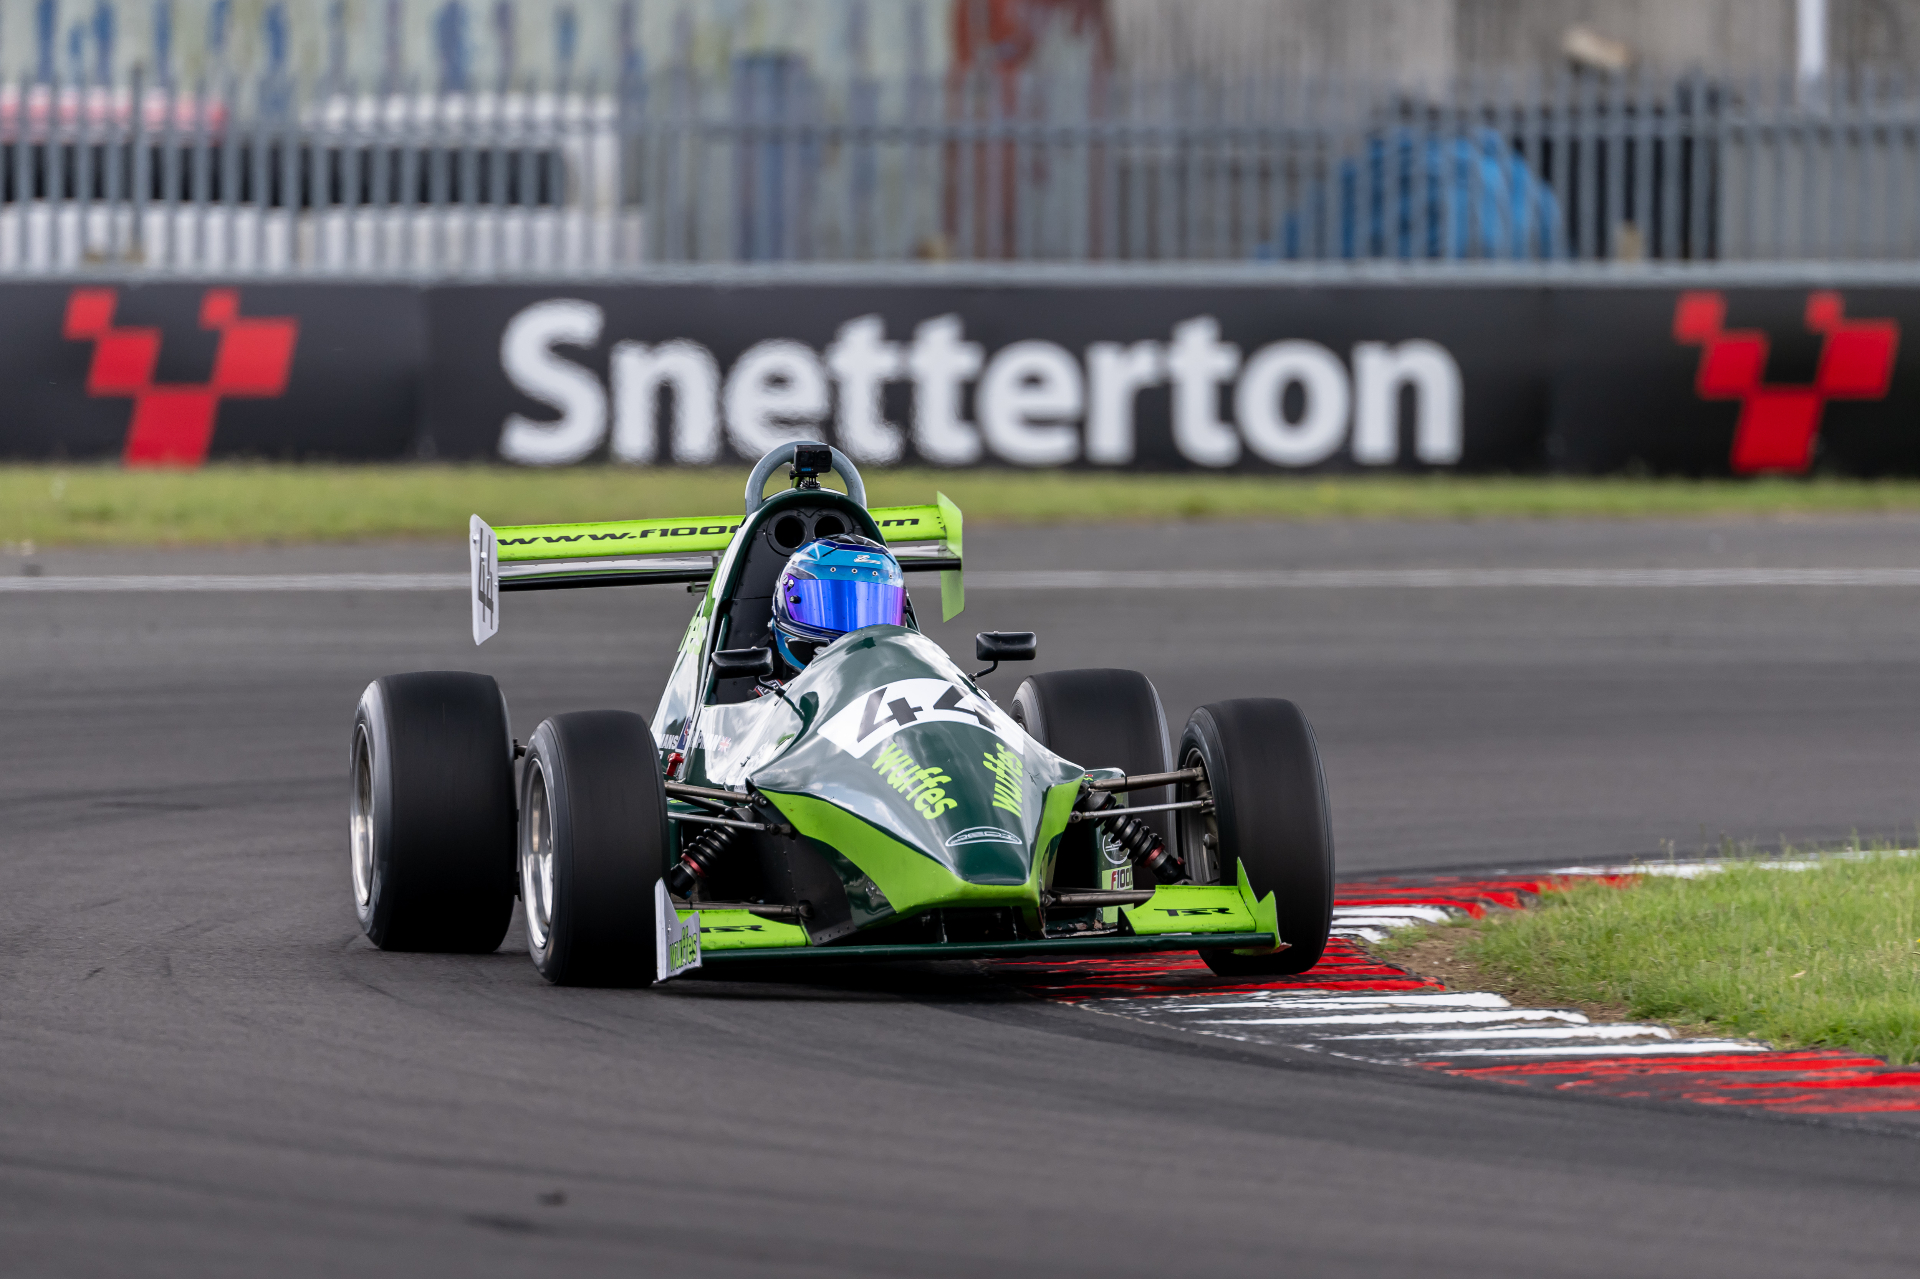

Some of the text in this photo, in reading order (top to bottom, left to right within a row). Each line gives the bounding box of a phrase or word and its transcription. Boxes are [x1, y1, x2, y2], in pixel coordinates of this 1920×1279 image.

[498, 299, 1464, 467] Snetterton
[856, 684, 1000, 743] 44
[872, 742, 958, 820] wuffes
[982, 742, 1024, 818] wuffes
[669, 925, 698, 973] wuffes
